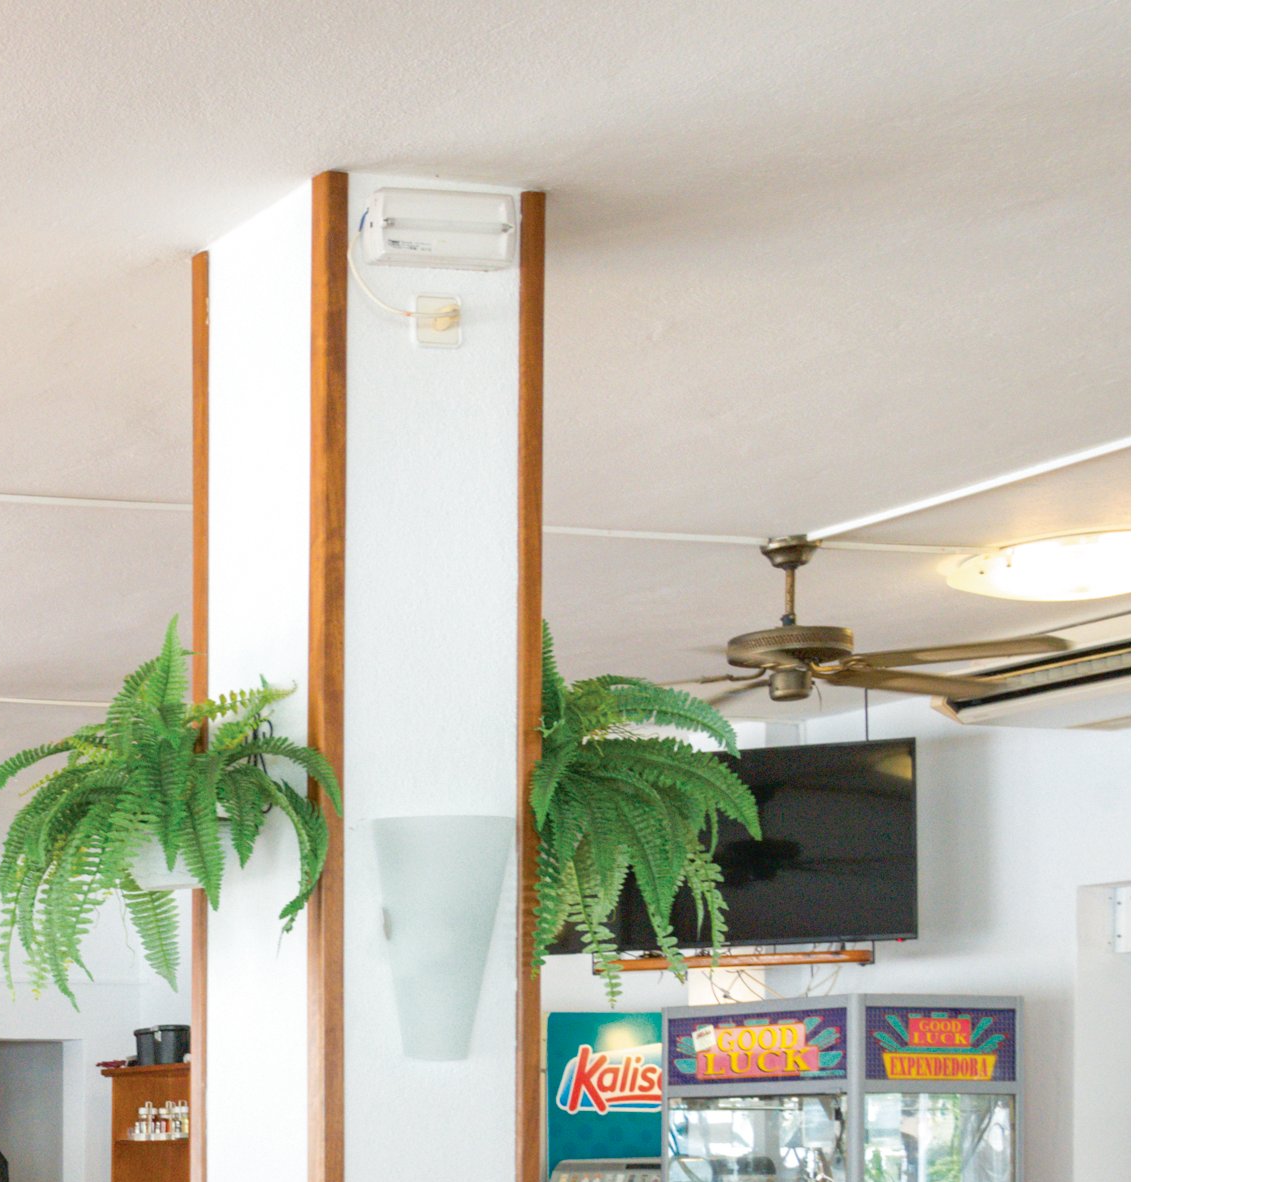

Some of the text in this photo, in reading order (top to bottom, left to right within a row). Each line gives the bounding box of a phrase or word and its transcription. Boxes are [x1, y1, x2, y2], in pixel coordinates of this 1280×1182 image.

[919, 1020, 962, 1032] GOOD
[717, 1026, 799, 1052] GOOD
[913, 1032, 967, 1045] LUCK
[704, 1049, 811, 1075] LUCK
[891, 1056, 988, 1077] EXPENDEDORA
[569, 1047, 662, 1111] Kalis
